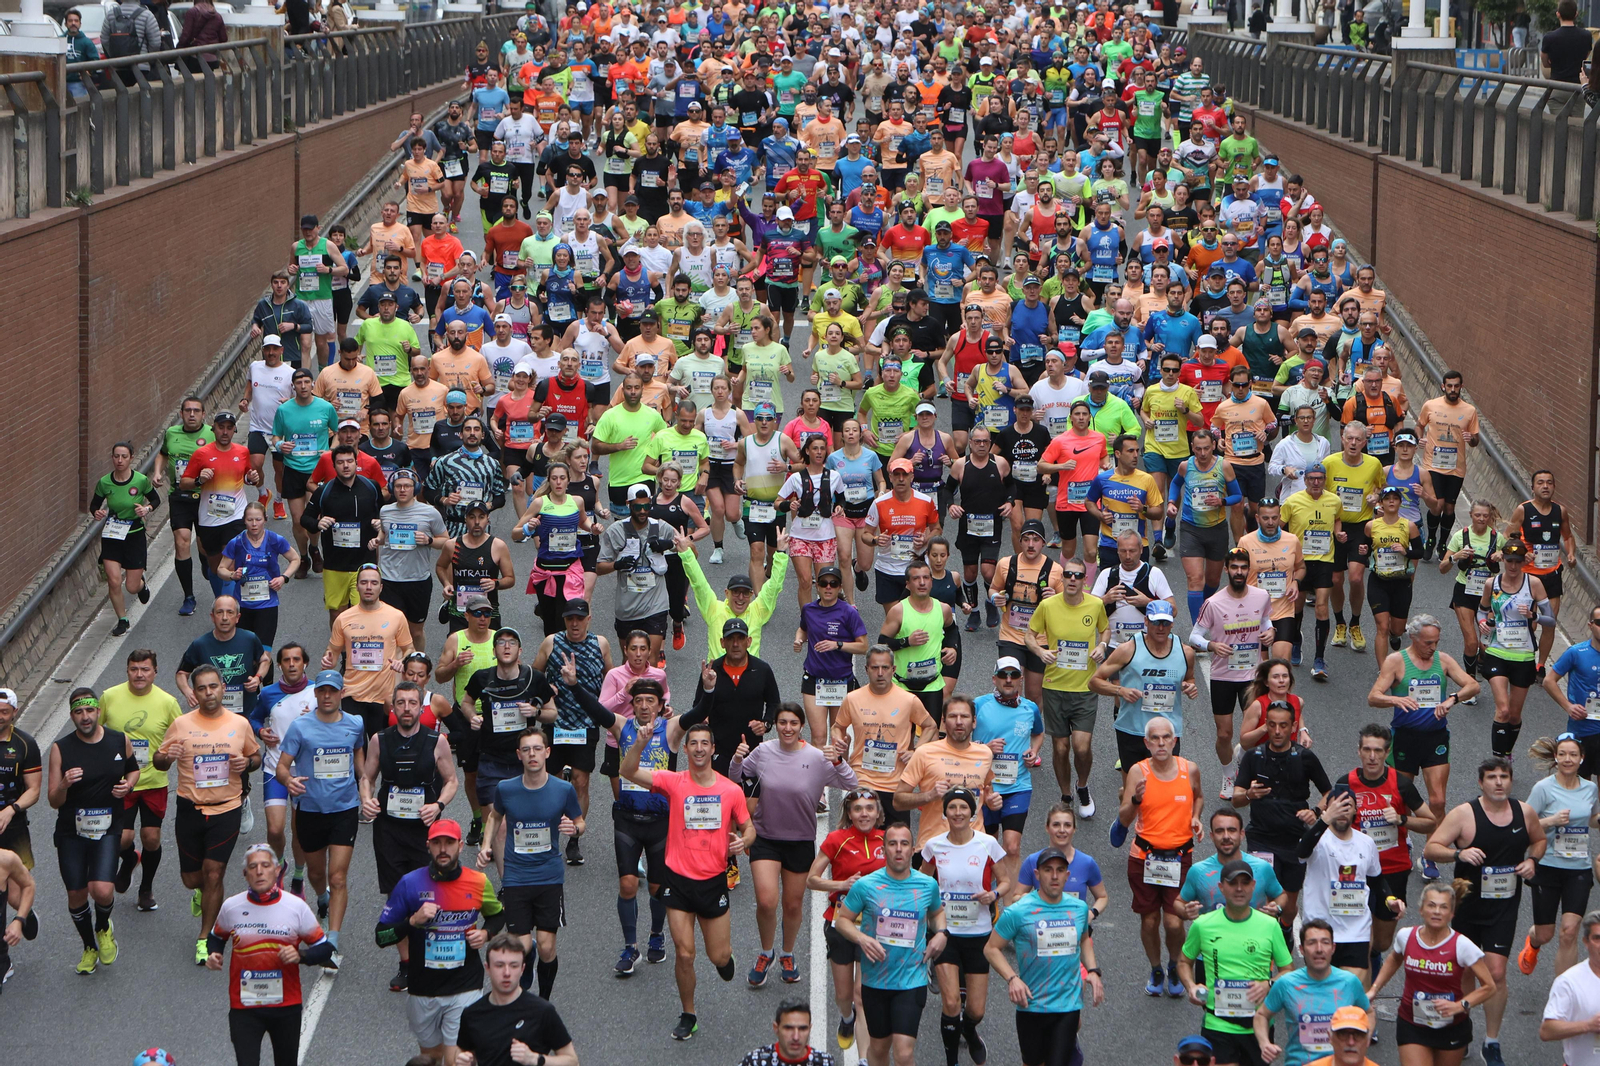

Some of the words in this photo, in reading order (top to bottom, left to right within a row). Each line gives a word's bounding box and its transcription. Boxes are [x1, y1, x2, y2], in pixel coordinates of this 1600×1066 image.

[1012, 447, 1038, 455] Chicago
[1108, 488, 1142, 498] agustinos
[892, 911, 915, 919] ZURICH
[1406, 955, 1453, 973] Run2Forty2
